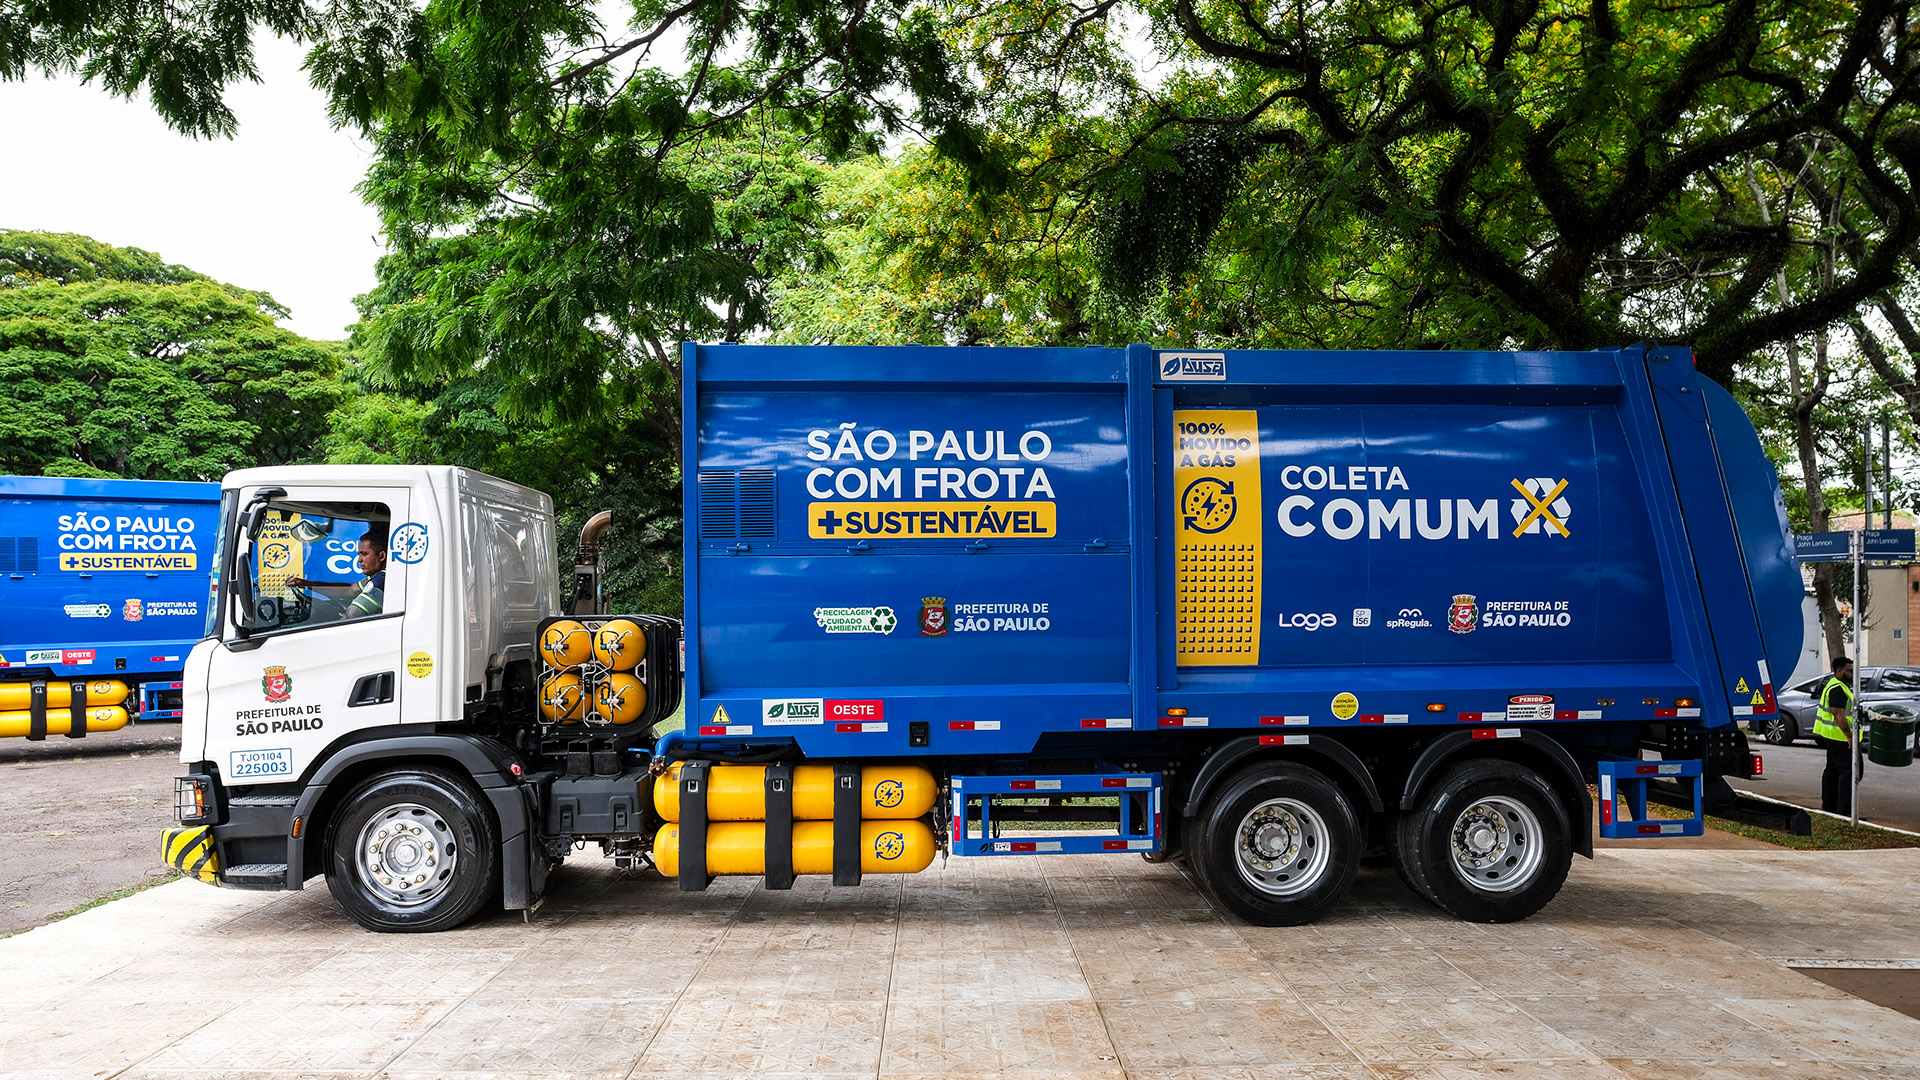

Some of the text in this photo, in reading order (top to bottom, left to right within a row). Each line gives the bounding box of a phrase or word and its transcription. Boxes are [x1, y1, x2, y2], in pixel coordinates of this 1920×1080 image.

[1178, 422, 1226, 435] 100%
[806, 422, 1052, 461] SÃO PAULO
[1180, 438, 1251, 450] MOVIDO
[1180, 451, 1236, 468] A GÁS
[806, 468, 1055, 499] COM FROTA
[1280, 466, 1410, 490] COLETA
[58, 512, 195, 533] SÃO PAULO
[1278, 495, 1499, 540] COMUM
[58, 534, 196, 550] COM FROTA
[147, 608, 198, 616] SÃO PAULO
[955, 603, 1048, 614] PREFEITURA DE
[1486, 601, 1568, 611] PREFEITURA DE
[954, 616, 1050, 632] SÃO PAULO
[1482, 612, 1571, 627] SÃO PAULO
[236, 704, 321, 720] PREFEITURA DE
[834, 705, 874, 714] OESTE
[236, 718, 324, 736] SÃO PAULO
[236, 762, 287, 775] 225003
